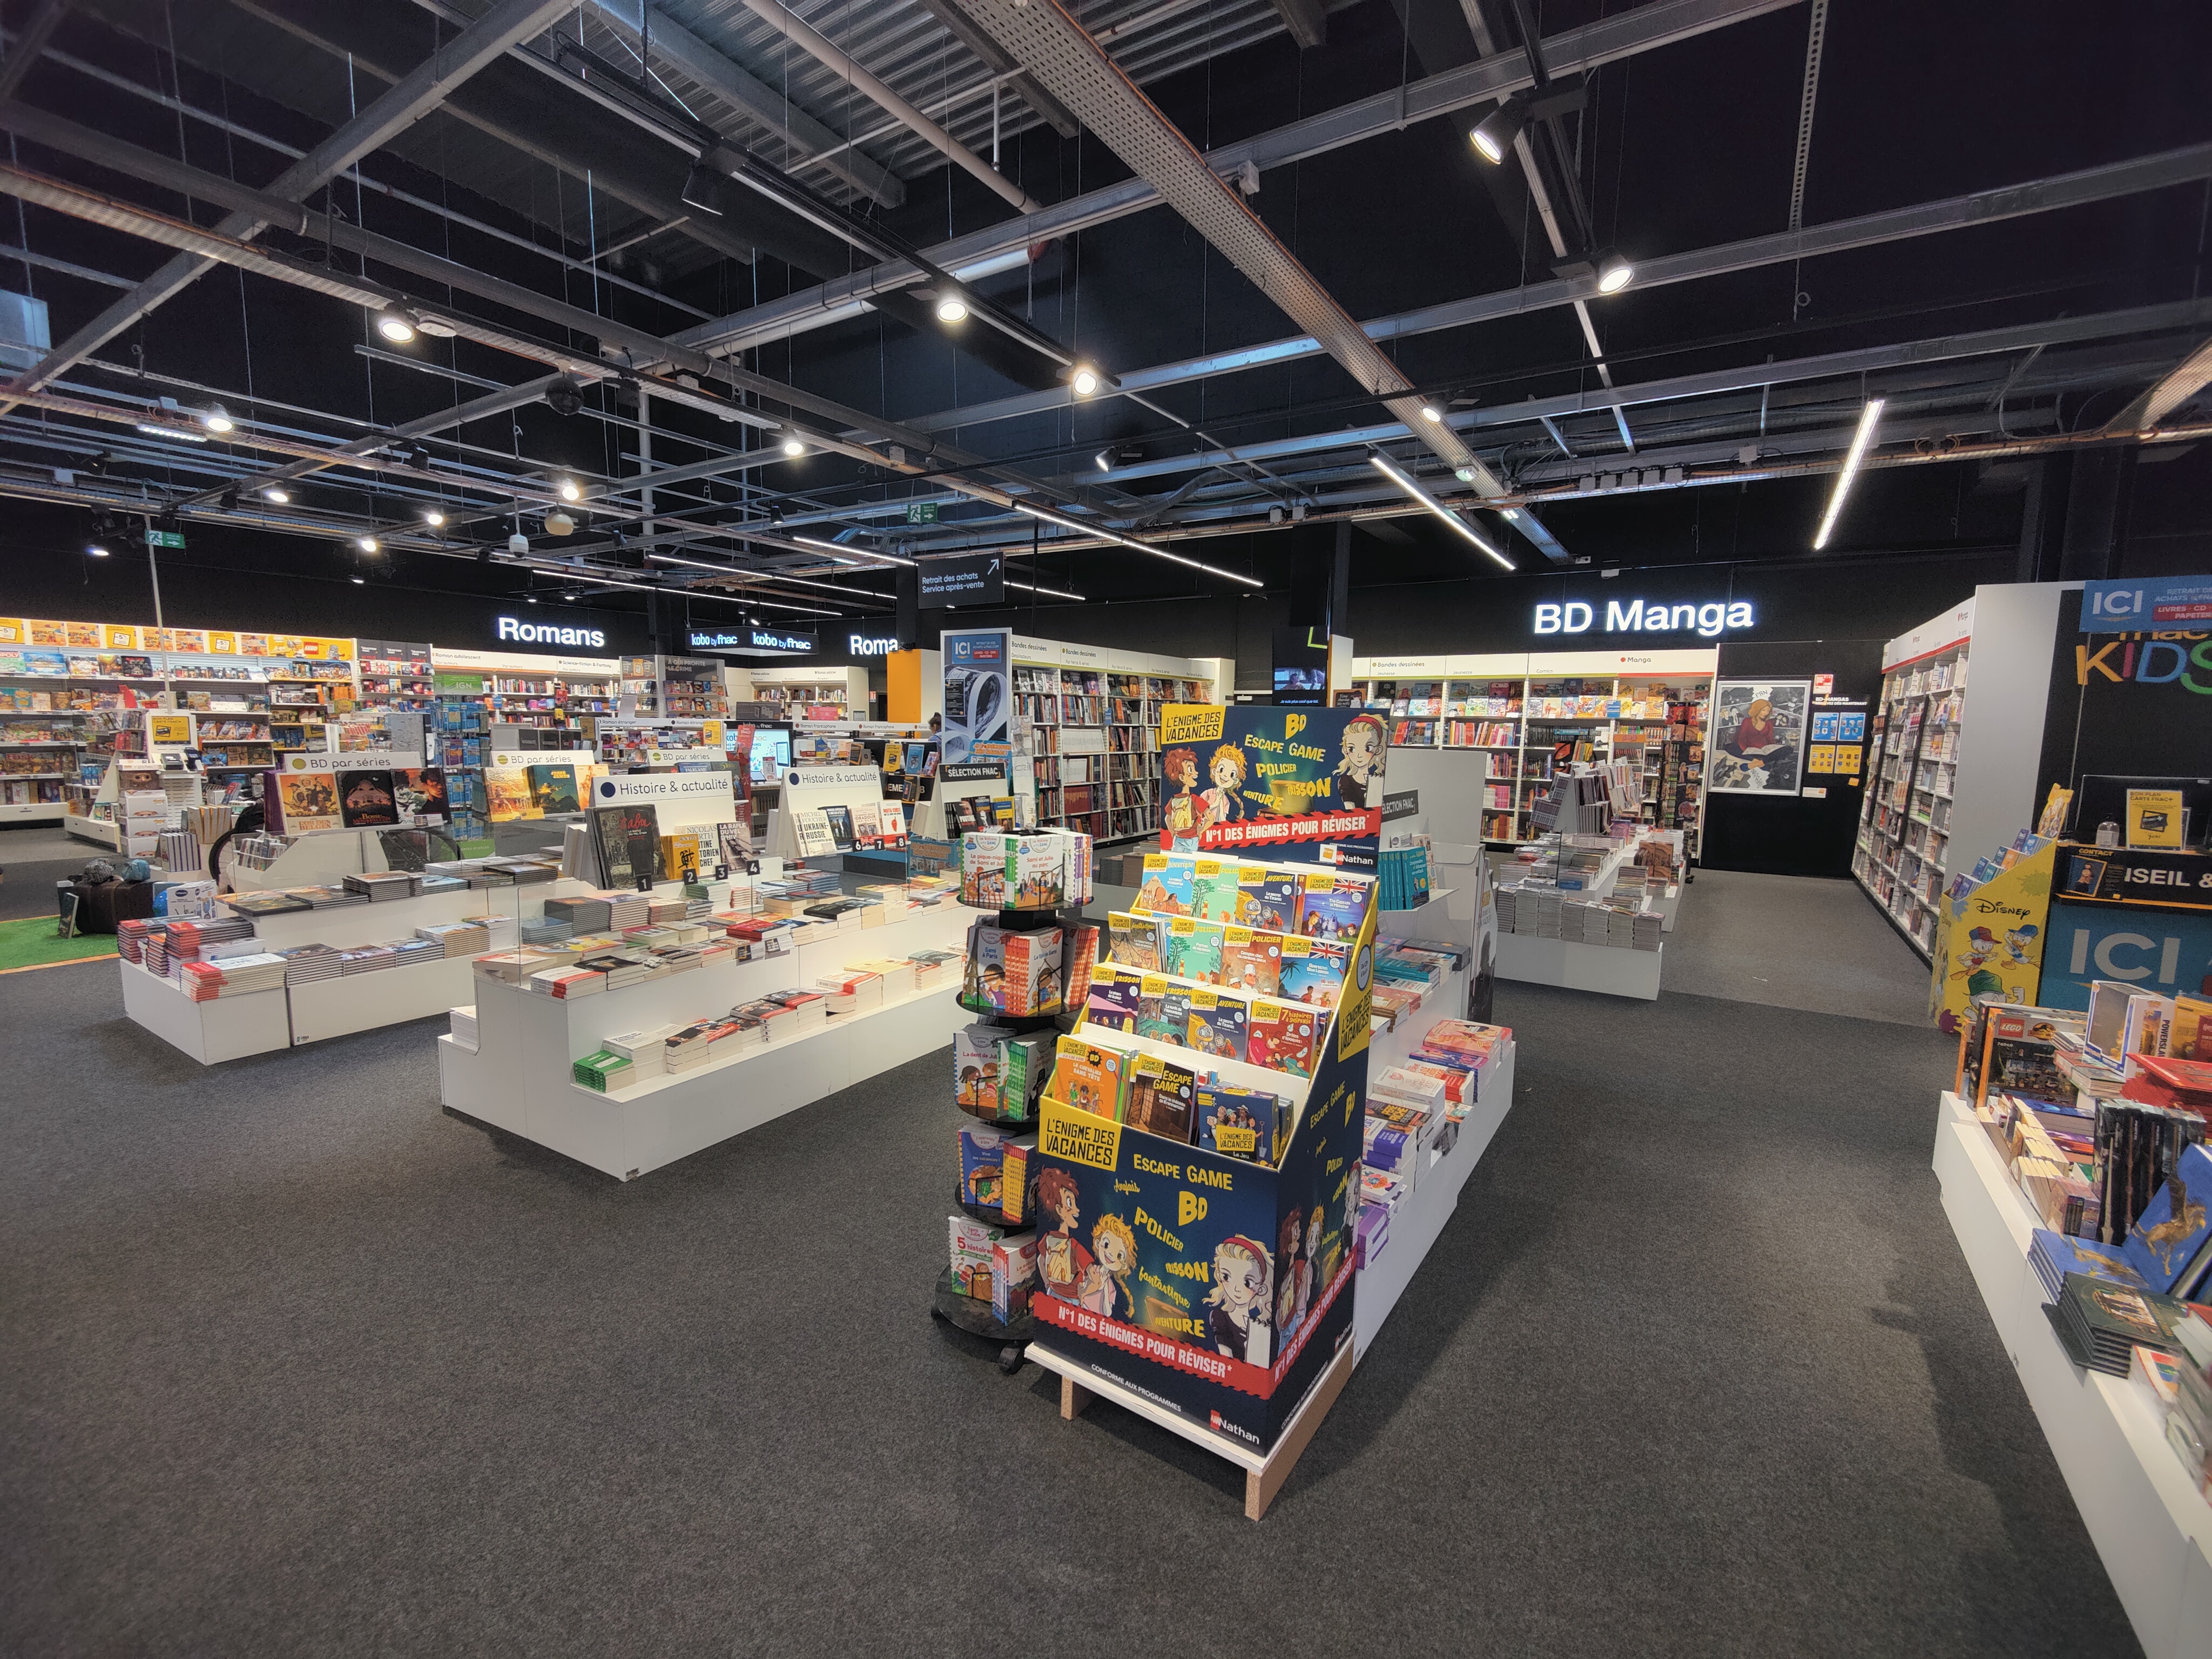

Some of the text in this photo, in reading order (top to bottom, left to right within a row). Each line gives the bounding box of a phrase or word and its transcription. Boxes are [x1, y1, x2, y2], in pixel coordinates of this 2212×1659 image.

[922, 572, 978, 584] Retrait des achats
[922, 581, 984, 594] Service après-vente
[2092, 590, 2143, 615] ICI
[1534, 599, 1754, 637] BD Manga
[498, 617, 604, 648] Romans
[691, 633, 738, 646] kobo by fnac
[753, 632, 811, 650] kobo by fnac
[955, 642, 970, 655] ICI
[1011, 641, 1047, 652] Bandes dessinées
[1166, 712, 1220, 728] L'ÉNIGME DES
[1285, 713, 1307, 740] BD
[1166, 724, 1219, 741] VACANCES
[1244, 734, 1326, 763] ESCAPE GAME
[311, 757, 391, 769] BD par séries
[511, 755, 571, 765] BD par séries
[802, 772, 877, 783] Histoire & actualité
[948, 767, 998, 777] SÉLECTION FNAC
[1256, 763, 1297, 778] POLICIER
[621, 779, 728, 795] Histoire & actualité
[1242, 790, 1284, 811] AVENTURE
[1382, 797, 1414, 814] ÉLECTION FNAC
[806, 831, 826, 840] RUSSIE
[1225, 827, 1243, 841] DES
[1245, 822, 1289, 839] ÉNIGMES
[1291, 820, 1318, 835] POUR
[855, 841, 861, 849] 6
[877, 841, 882, 849] 7
[899, 838, 905, 846] 8
[1343, 854, 1373, 865] Nathan
[2079, 848, 2114, 857] CONTACT
[719, 867, 725, 878] 3
[750, 863, 758, 872] 4
[642, 879, 647, 889] 1
[687, 872, 693, 882] 2
[1252, 935, 1282, 943] POLICIER
[2069, 928, 2181, 984] ICI
[1115, 975, 1141, 983] FRISSON
[1217, 1000, 1246, 1009] AVENTURE
[1282, 1009, 1289, 1021] 7
[2000, 1023, 2022, 1032] LEGO
[1089, 1054, 1099, 1062] BD
[1073, 1068, 1101, 1082] SANS TÊTE
[1080, 1064, 1102, 1075] CHEVALIER
[1163, 1070, 1193, 1086] ESCAPE
[1153, 1079, 1180, 1094] GAME
[1310, 1080, 1345, 1130] ESCAPE GAME
[1344, 1090, 1355, 1128] BD
[1046, 1118, 1115, 1146] L'ÉNIGME DES
[1046, 1135, 1114, 1168] VACANCES
[1220, 1140, 1252, 1149] VACANCES
[1134, 1154, 1233, 1191] ESCAPE GAME
[1114, 1178, 1141, 1195] Anglais
[1178, 1190, 1208, 1226] BD
[1134, 1206, 1184, 1253] POLICIER
[1165, 1260, 1210, 1283] FRISSON
[1138, 1265, 1191, 1309] fantastique
[1154, 1316, 1206, 1339] AVENTURE
[1077, 1313, 1097, 1332] DES
[1098, 1318, 1144, 1349] ÉNIGMES
[1146, 1337, 1175, 1365] POUR
[1091, 1363, 1182, 1412] CONFORME AUX PROGRAMMES
[1218, 1417, 1260, 1445] Nathan
